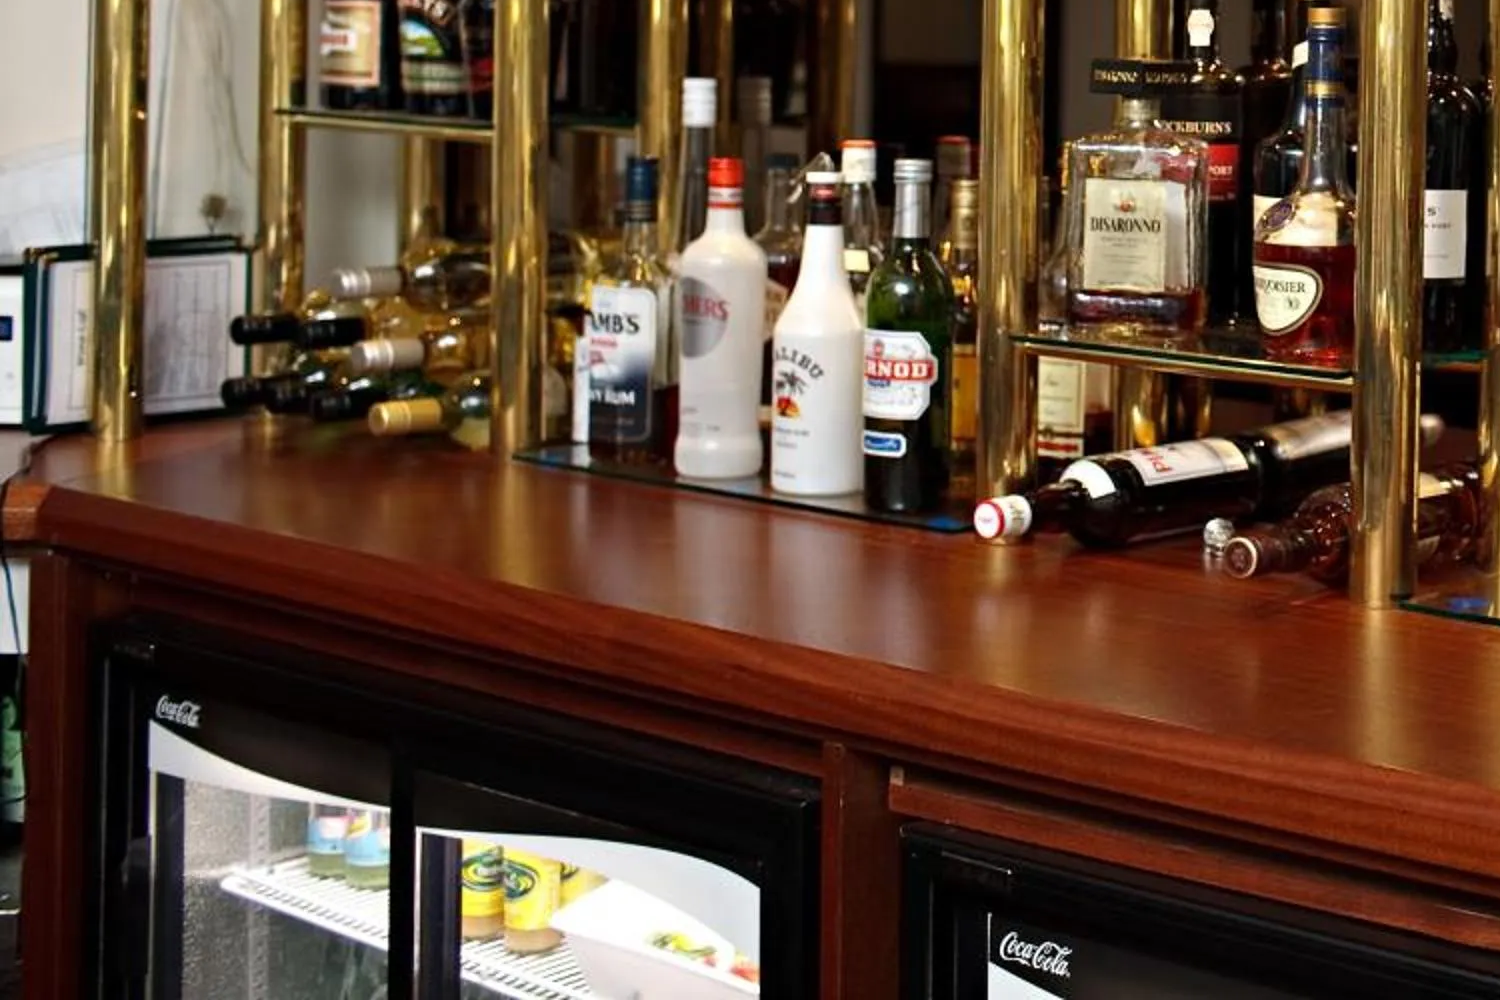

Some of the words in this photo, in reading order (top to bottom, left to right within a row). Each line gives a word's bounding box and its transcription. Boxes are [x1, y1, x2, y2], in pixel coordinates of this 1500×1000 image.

[1090, 216, 1161, 234] DISARONNO
[604, 392, 636, 407] RUM
[1000, 932, 1072, 977] Coca-Cola
